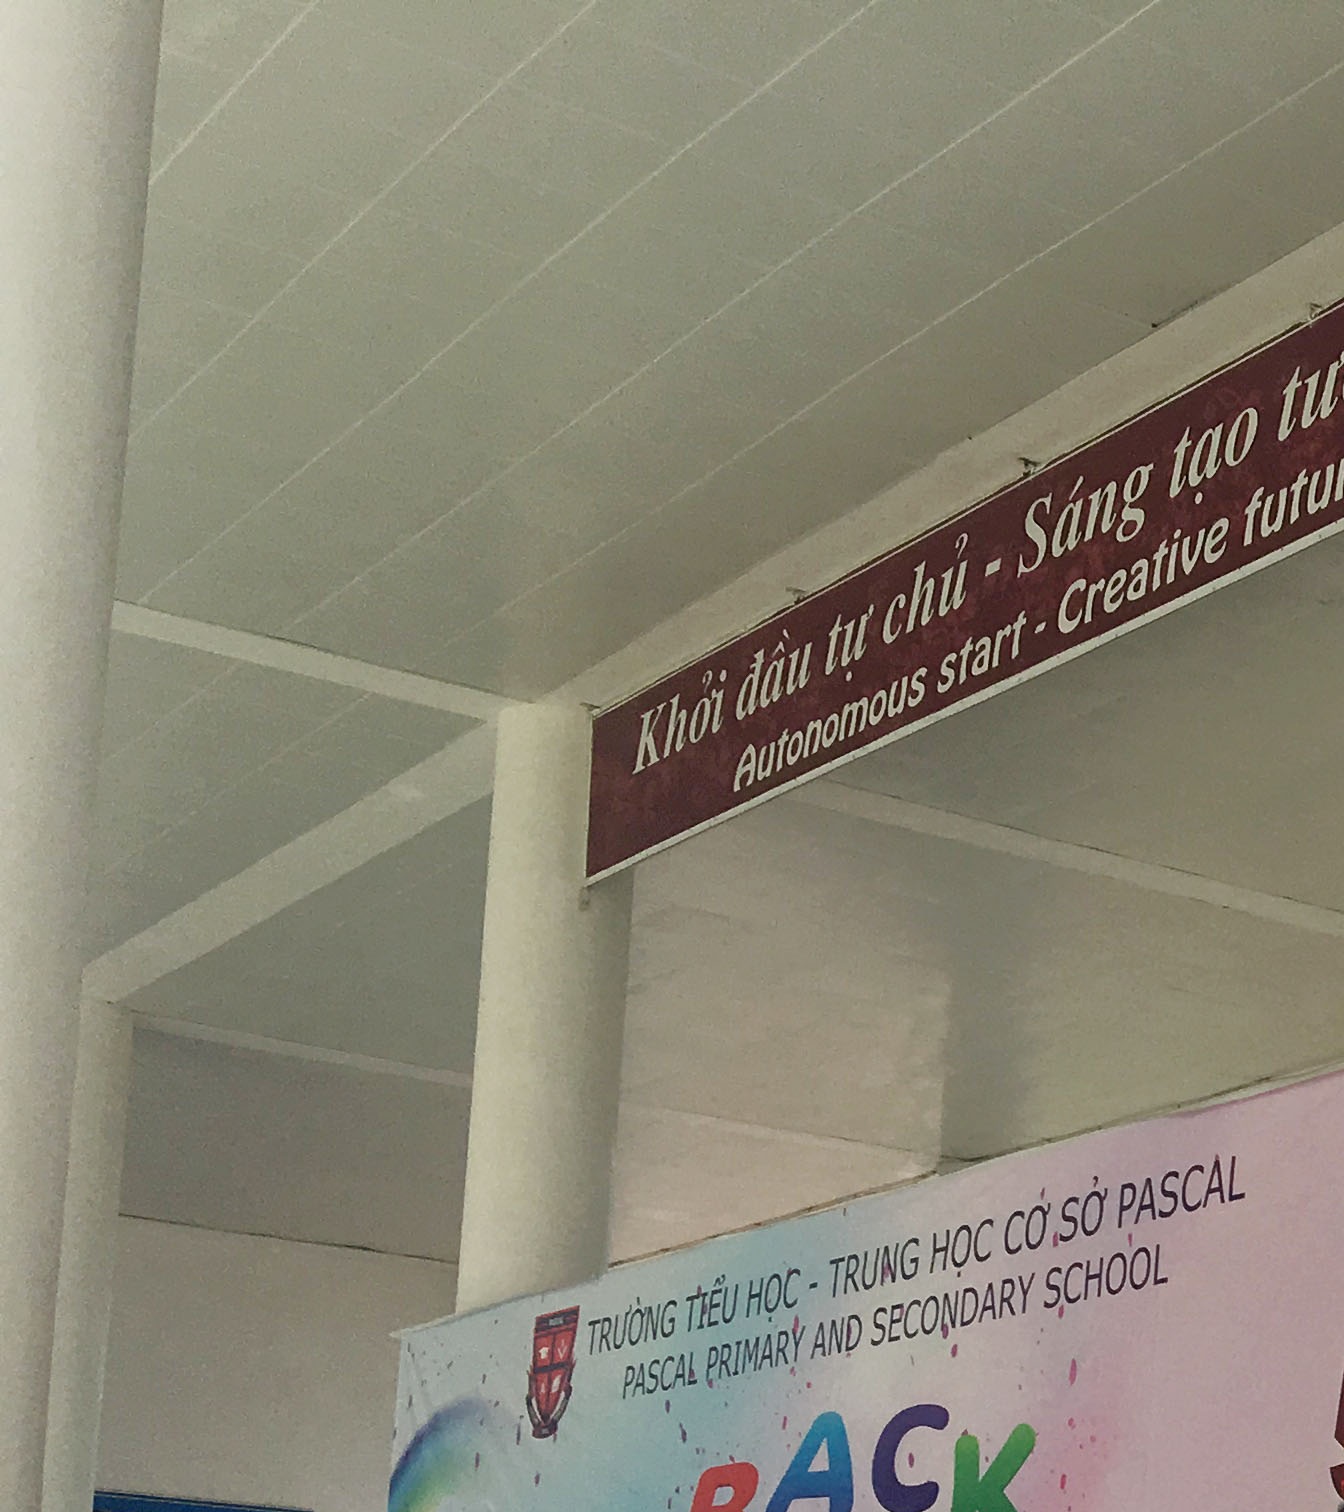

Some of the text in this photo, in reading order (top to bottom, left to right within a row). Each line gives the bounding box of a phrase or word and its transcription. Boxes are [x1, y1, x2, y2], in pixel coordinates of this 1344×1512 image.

[632, 669, 727, 775] Khởi
[735, 630, 813, 721] đầu
[825, 604, 874, 682] tự
[882, 533, 968, 645] chủ
[985, 558, 1001, 577] -
[1016, 476, 1154, 577] Sáng
[1169, 407, 1258, 505] tạo
[733, 668, 927, 792] Autonomous
[937, 610, 1026, 694] start
[1058, 517, 1229, 634] Creative
[588, 1155, 1246, 1355] TRƯỜNG TIỂU HỌC - TRUNG HỌC CƠ SỞ PASCAL
[622, 1244, 1169, 1399] PASCAL PRIMARY AND SECONDARY SCHOOL
